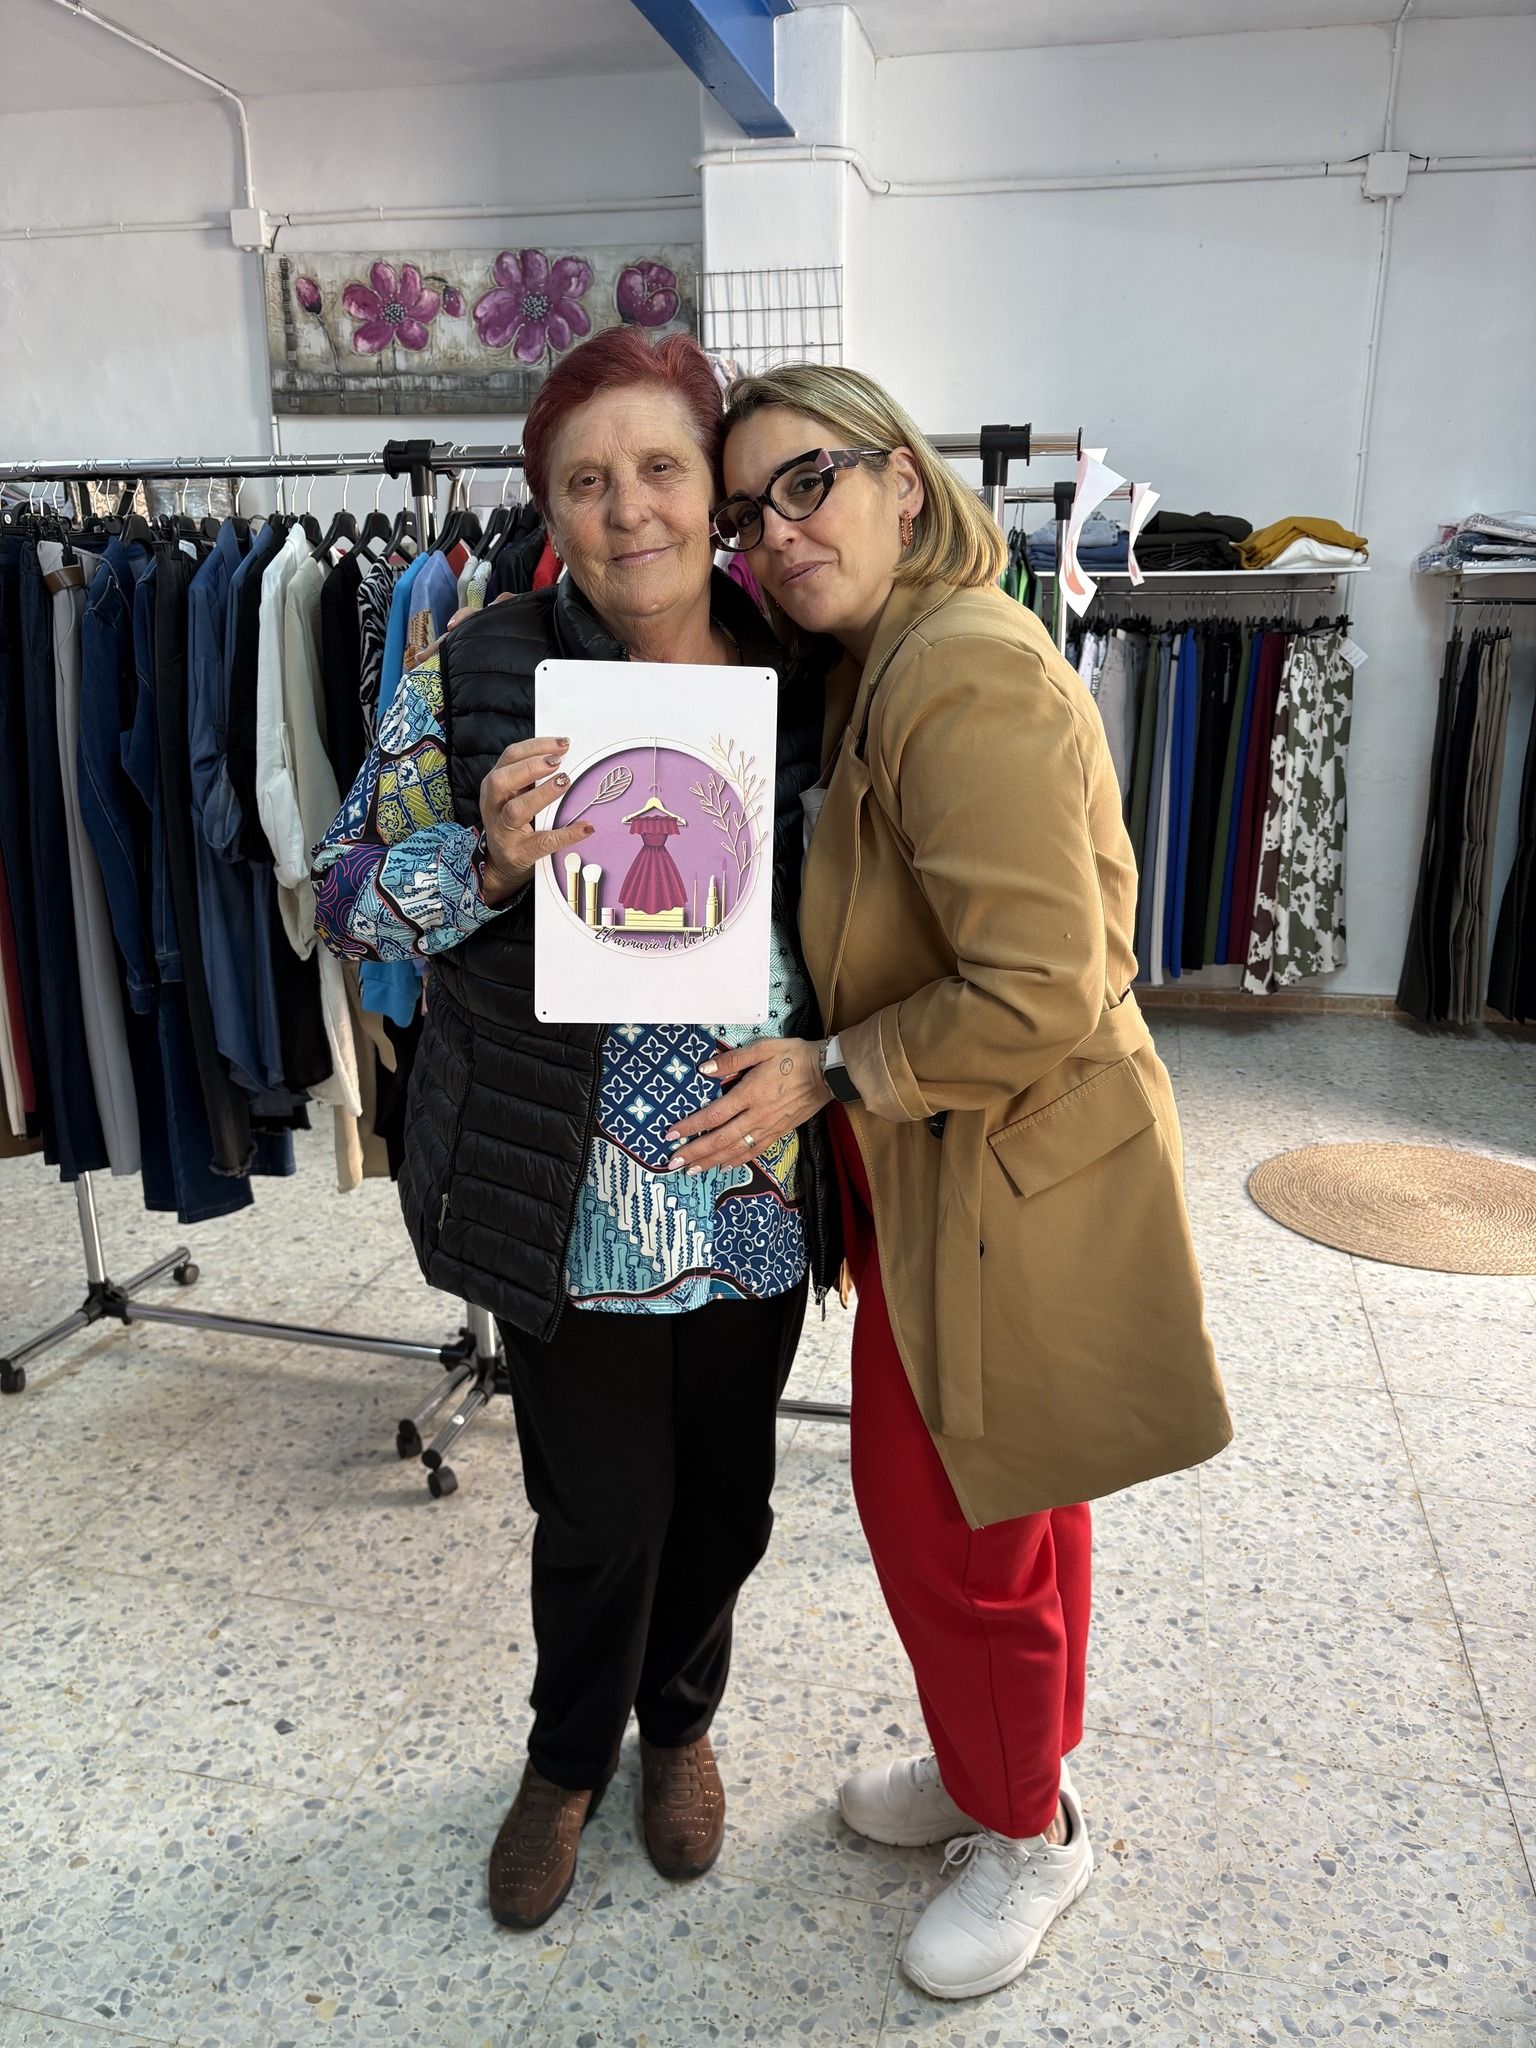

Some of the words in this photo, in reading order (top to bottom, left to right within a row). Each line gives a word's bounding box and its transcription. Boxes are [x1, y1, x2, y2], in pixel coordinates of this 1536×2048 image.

[595, 926, 615, 943] El
[614, 936, 661, 951] armario
[664, 935, 681, 951] de
[683, 931, 697, 949] la
[701, 923, 727, 942] Lore
